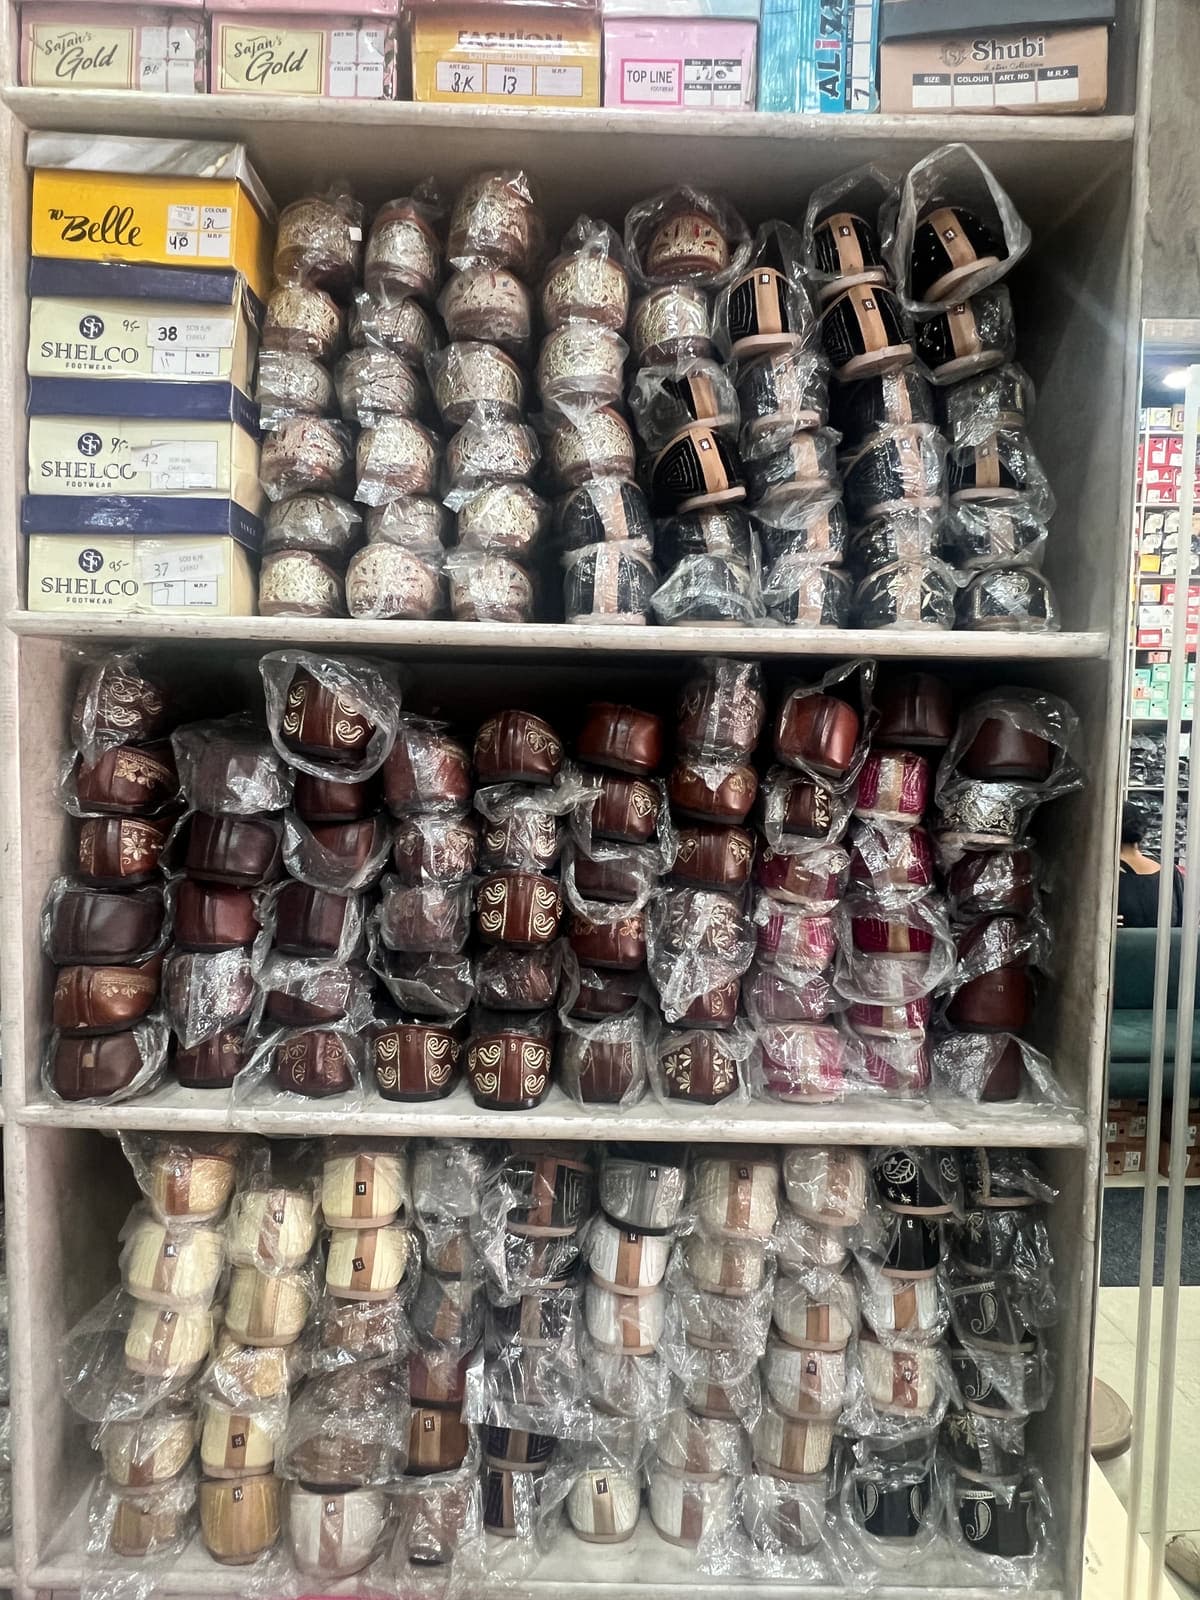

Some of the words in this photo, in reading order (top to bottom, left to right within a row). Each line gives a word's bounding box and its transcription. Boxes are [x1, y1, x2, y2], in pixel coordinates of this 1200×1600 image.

[971, 36, 1045, 61] Shubi
[55, 44, 118, 80] Gold
[245, 48, 308, 85] Gold
[502, 75, 517, 94] 13
[626, 70, 647, 82] TOP
[650, 71, 673, 84] LINE
[61, 204, 143, 246] Belle
[158, 326, 178, 342] 38
[41, 341, 140, 364] SHELCO
[65, 362, 112, 370] FOOTWEAR
[41, 460, 137, 480] SHELCO
[141, 453, 158, 468] 42
[154, 562, 169, 578] 37
[41, 577, 139, 596] SHELCO
[511, 1043, 516, 1051] 9
